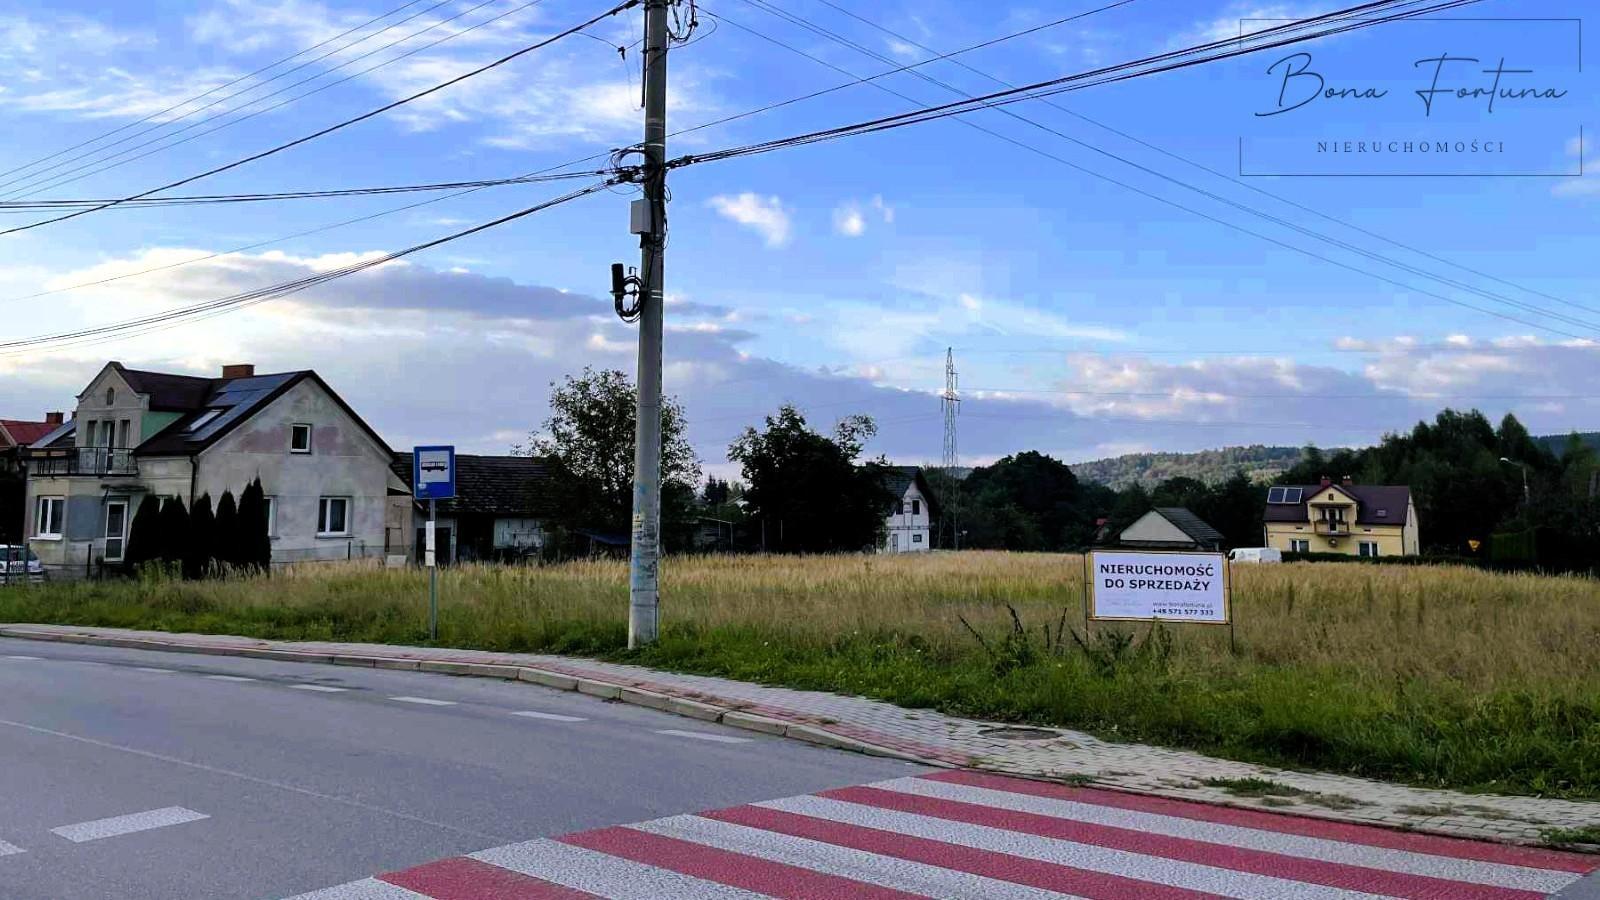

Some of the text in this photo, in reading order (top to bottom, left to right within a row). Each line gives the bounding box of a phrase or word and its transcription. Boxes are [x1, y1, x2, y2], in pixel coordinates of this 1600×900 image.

[1100, 563, 1214, 577] NIERUCHOMOŚĆ
[1105, 578, 1210, 591] DO SPRZEDAŻY
